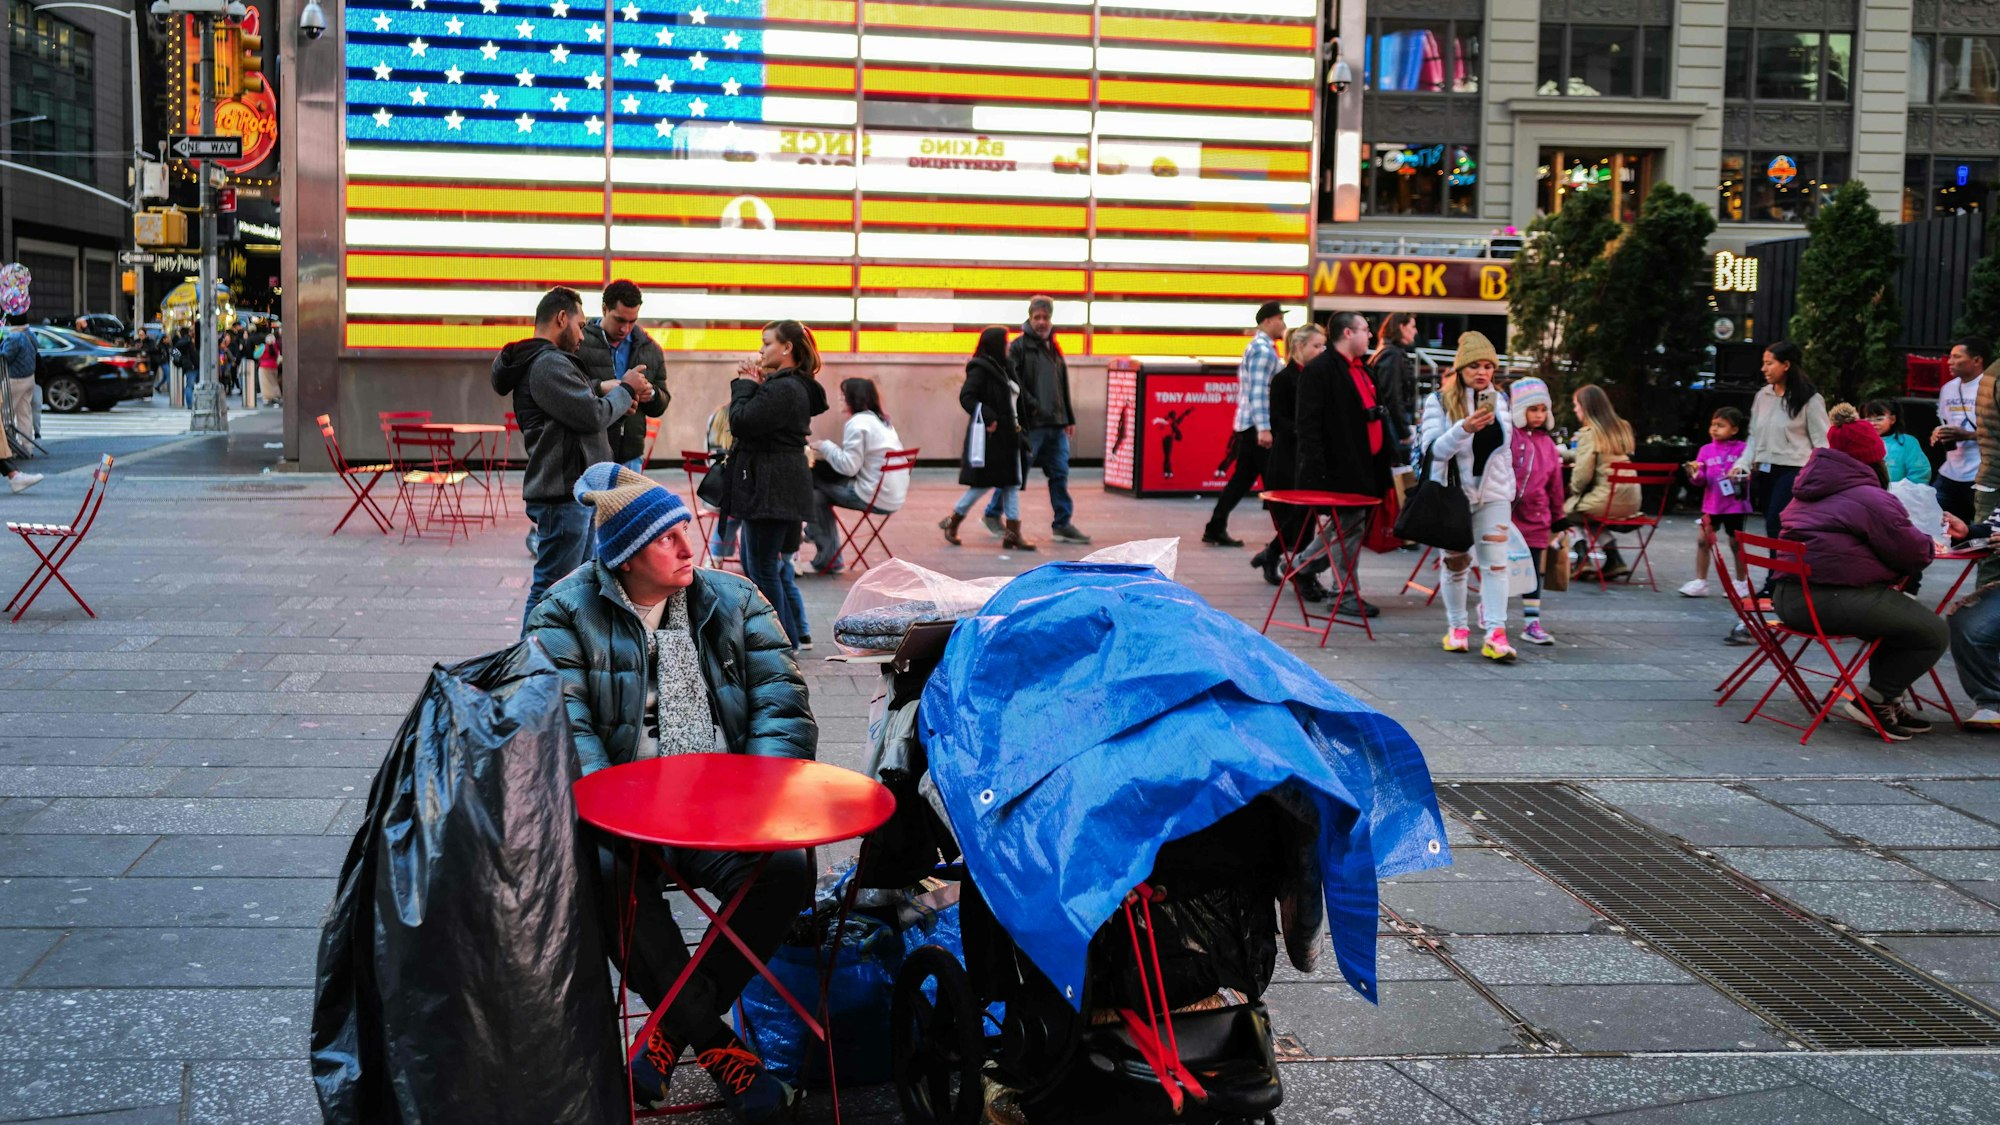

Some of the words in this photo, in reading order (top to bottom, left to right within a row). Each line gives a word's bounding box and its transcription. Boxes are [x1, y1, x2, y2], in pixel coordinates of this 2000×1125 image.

[236, 109, 279, 140] Rock
[180, 142, 201, 152] ONE
[211, 142, 233, 152] WAY
[154, 254, 177, 272] Harry
[1349, 262, 1448, 297] YORK
[1155, 392, 1183, 403] TONY
[1184, 392, 1221, 404] AWARD
